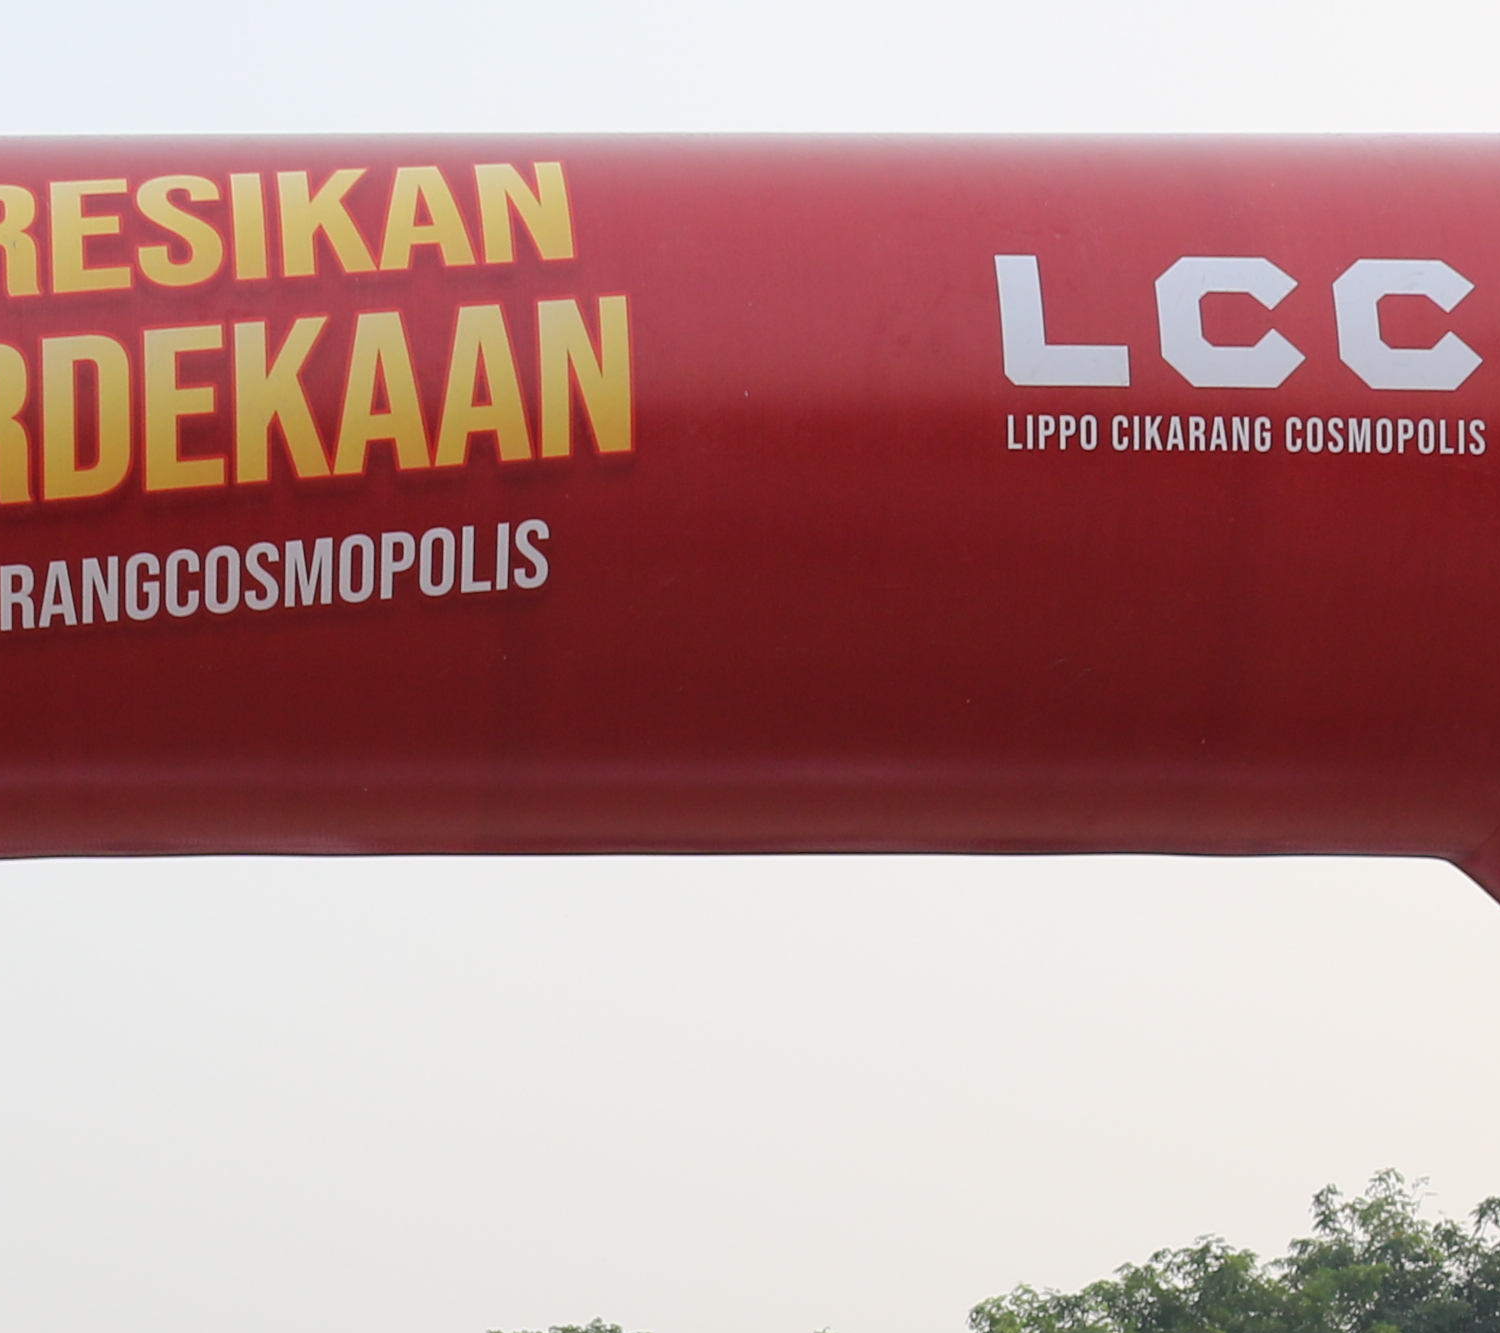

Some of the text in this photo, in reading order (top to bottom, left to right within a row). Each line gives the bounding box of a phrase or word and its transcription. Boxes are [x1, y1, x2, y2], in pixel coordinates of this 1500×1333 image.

[994, 254, 1483, 392] LCC
[1006, 414, 1487, 455] LIPPO CIKARANG COSMOPOLIS
